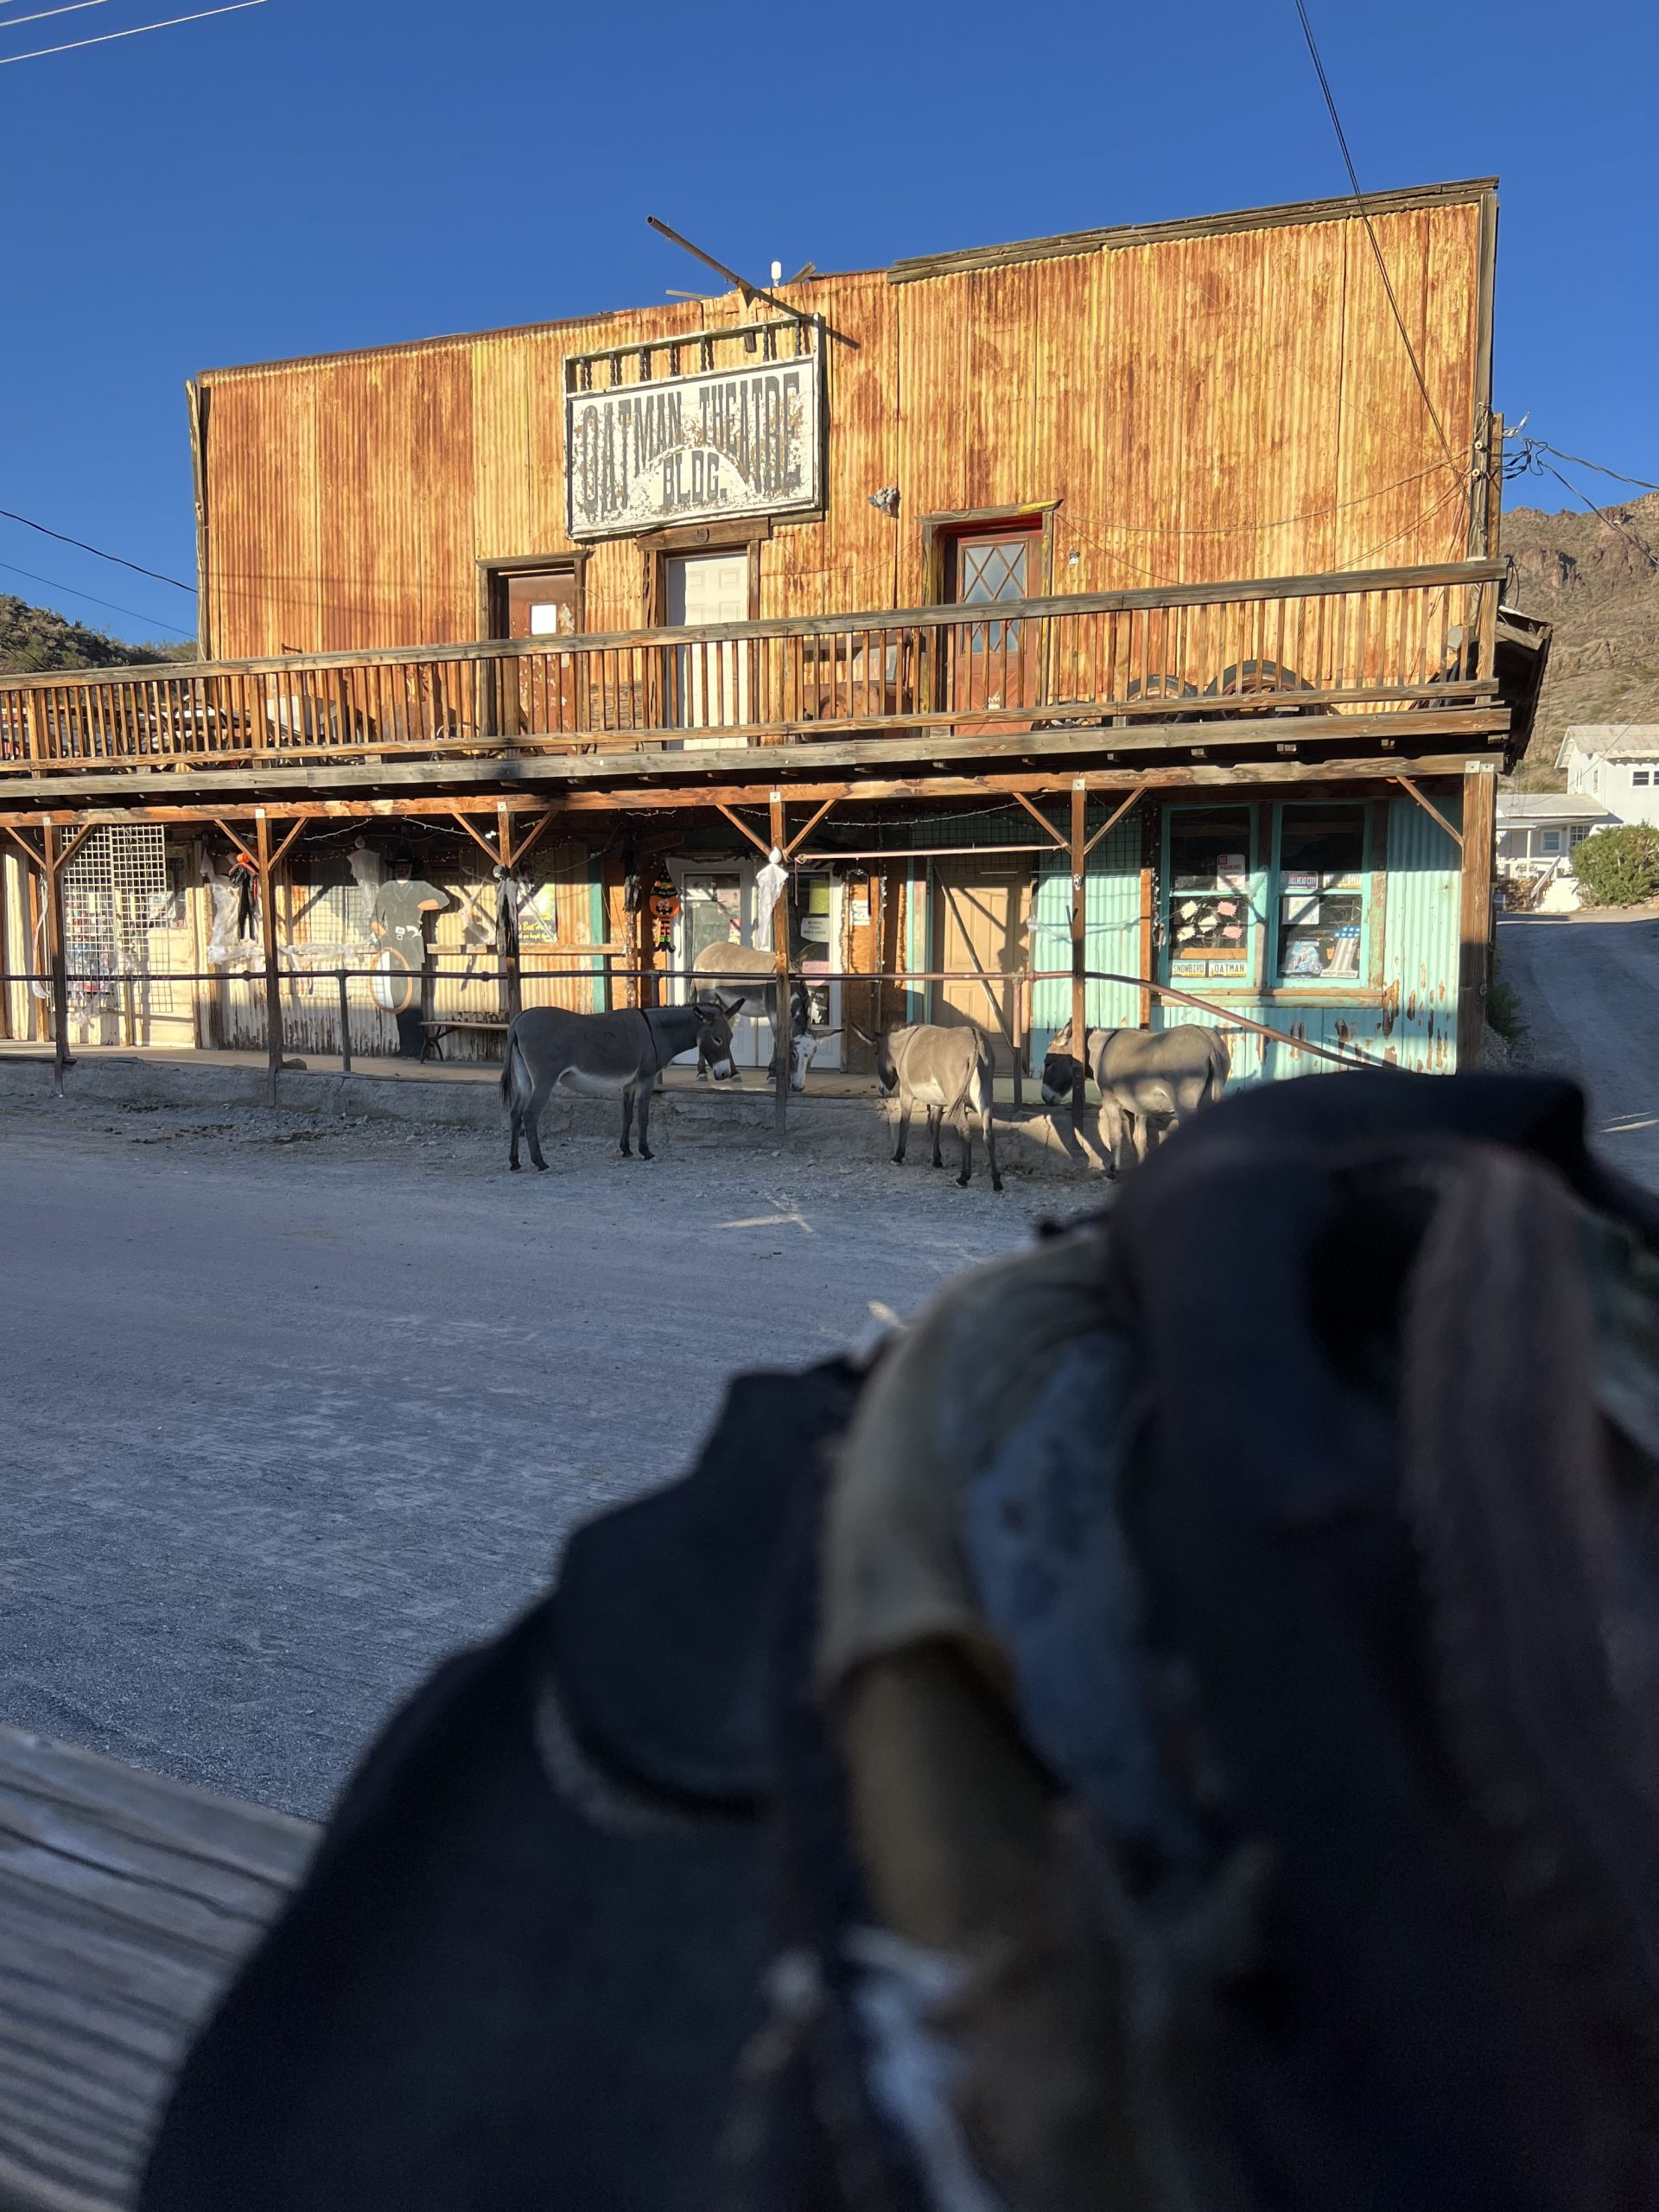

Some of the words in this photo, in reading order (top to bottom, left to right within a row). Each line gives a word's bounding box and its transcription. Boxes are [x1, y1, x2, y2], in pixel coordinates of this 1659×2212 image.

[582, 391, 683, 521] OATMAN
[698, 371, 802, 494] THEATRE
[663, 449, 728, 508] BLDG.
[1173, 963, 1205, 974] SNOWBIRD
[1214, 963, 1244, 973] OATMAN
